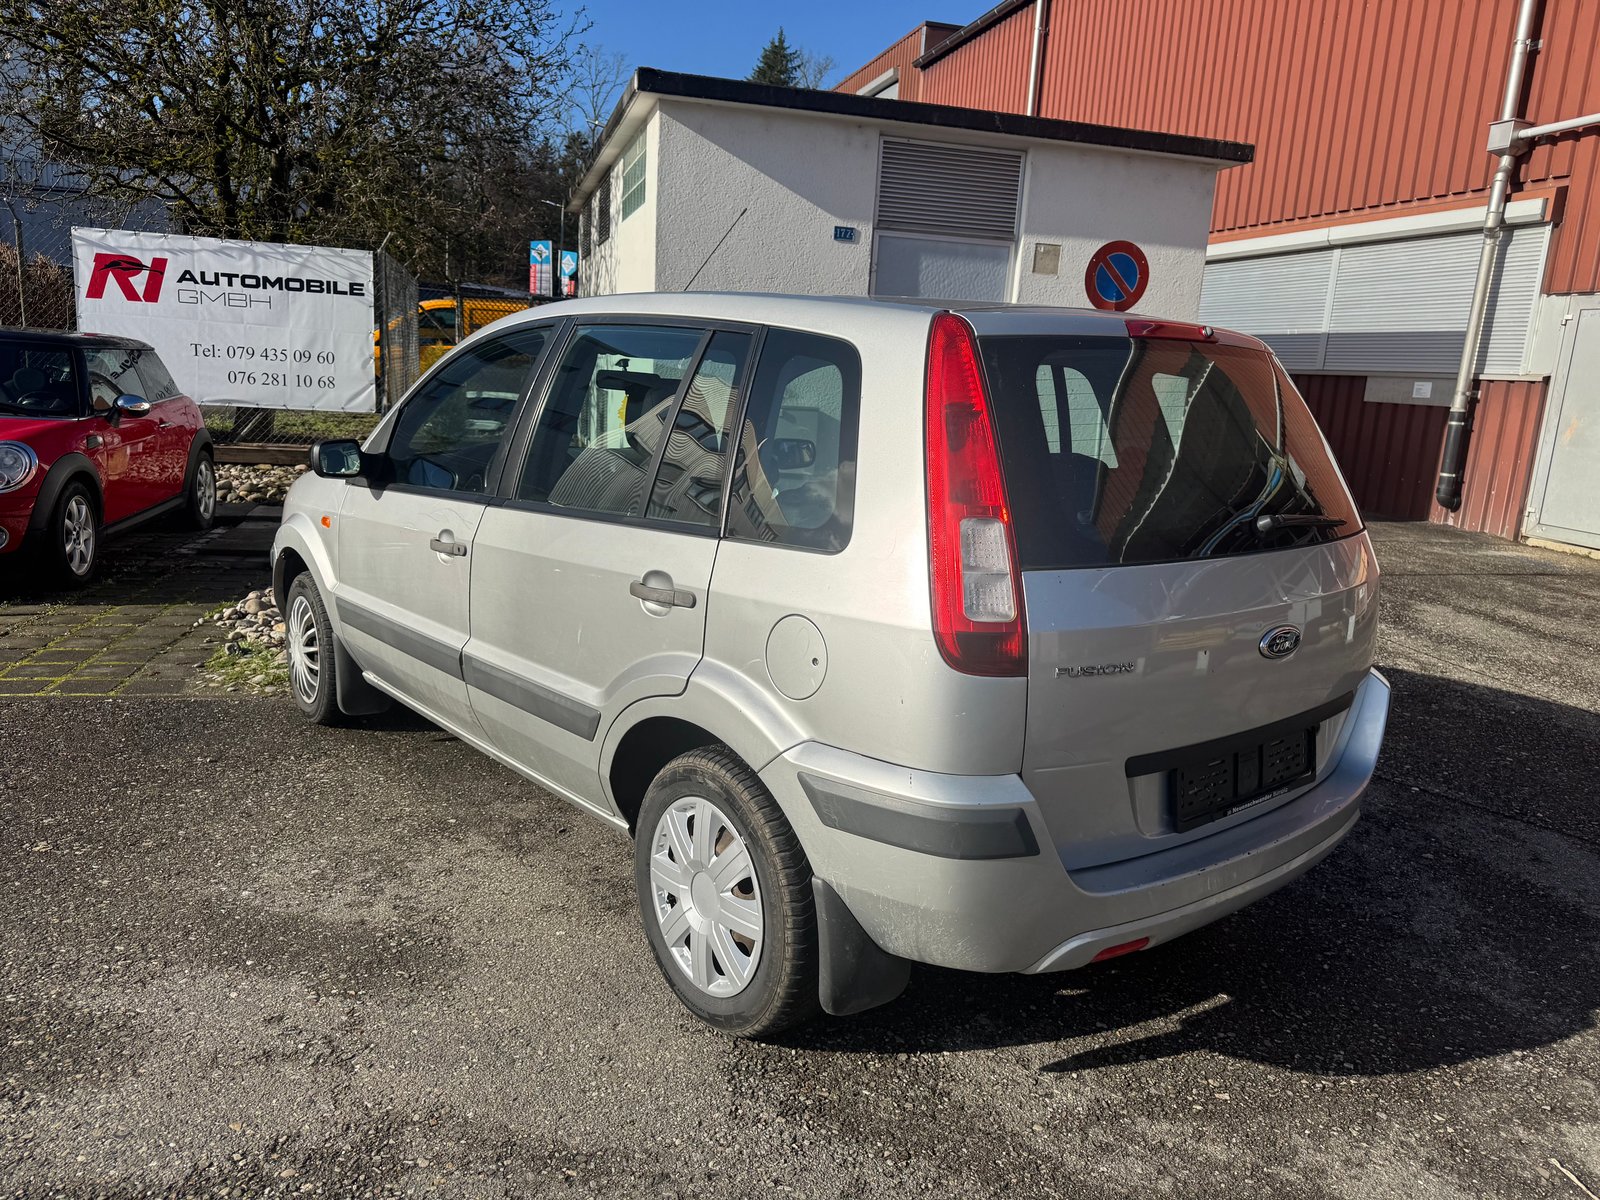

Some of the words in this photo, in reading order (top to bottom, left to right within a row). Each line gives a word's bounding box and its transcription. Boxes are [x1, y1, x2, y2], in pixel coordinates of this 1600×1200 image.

[85, 252, 168, 303] RI
[176, 269, 365, 297] AUTOMOBILE
[177, 288, 272, 310] GMBH
[190, 343, 221, 358] Tel:
[226, 345, 255, 360] 079
[260, 347, 288, 362] 435
[293, 349, 312, 363] 09
[316, 351, 335, 365] 60
[227, 370, 257, 385] 076
[261, 372, 288, 387] 281
[295, 374, 313, 388] 10
[317, 375, 336, 389] 68
[1273, 632, 1298, 653] Ford
[1054, 662, 1134, 679] FUSION
